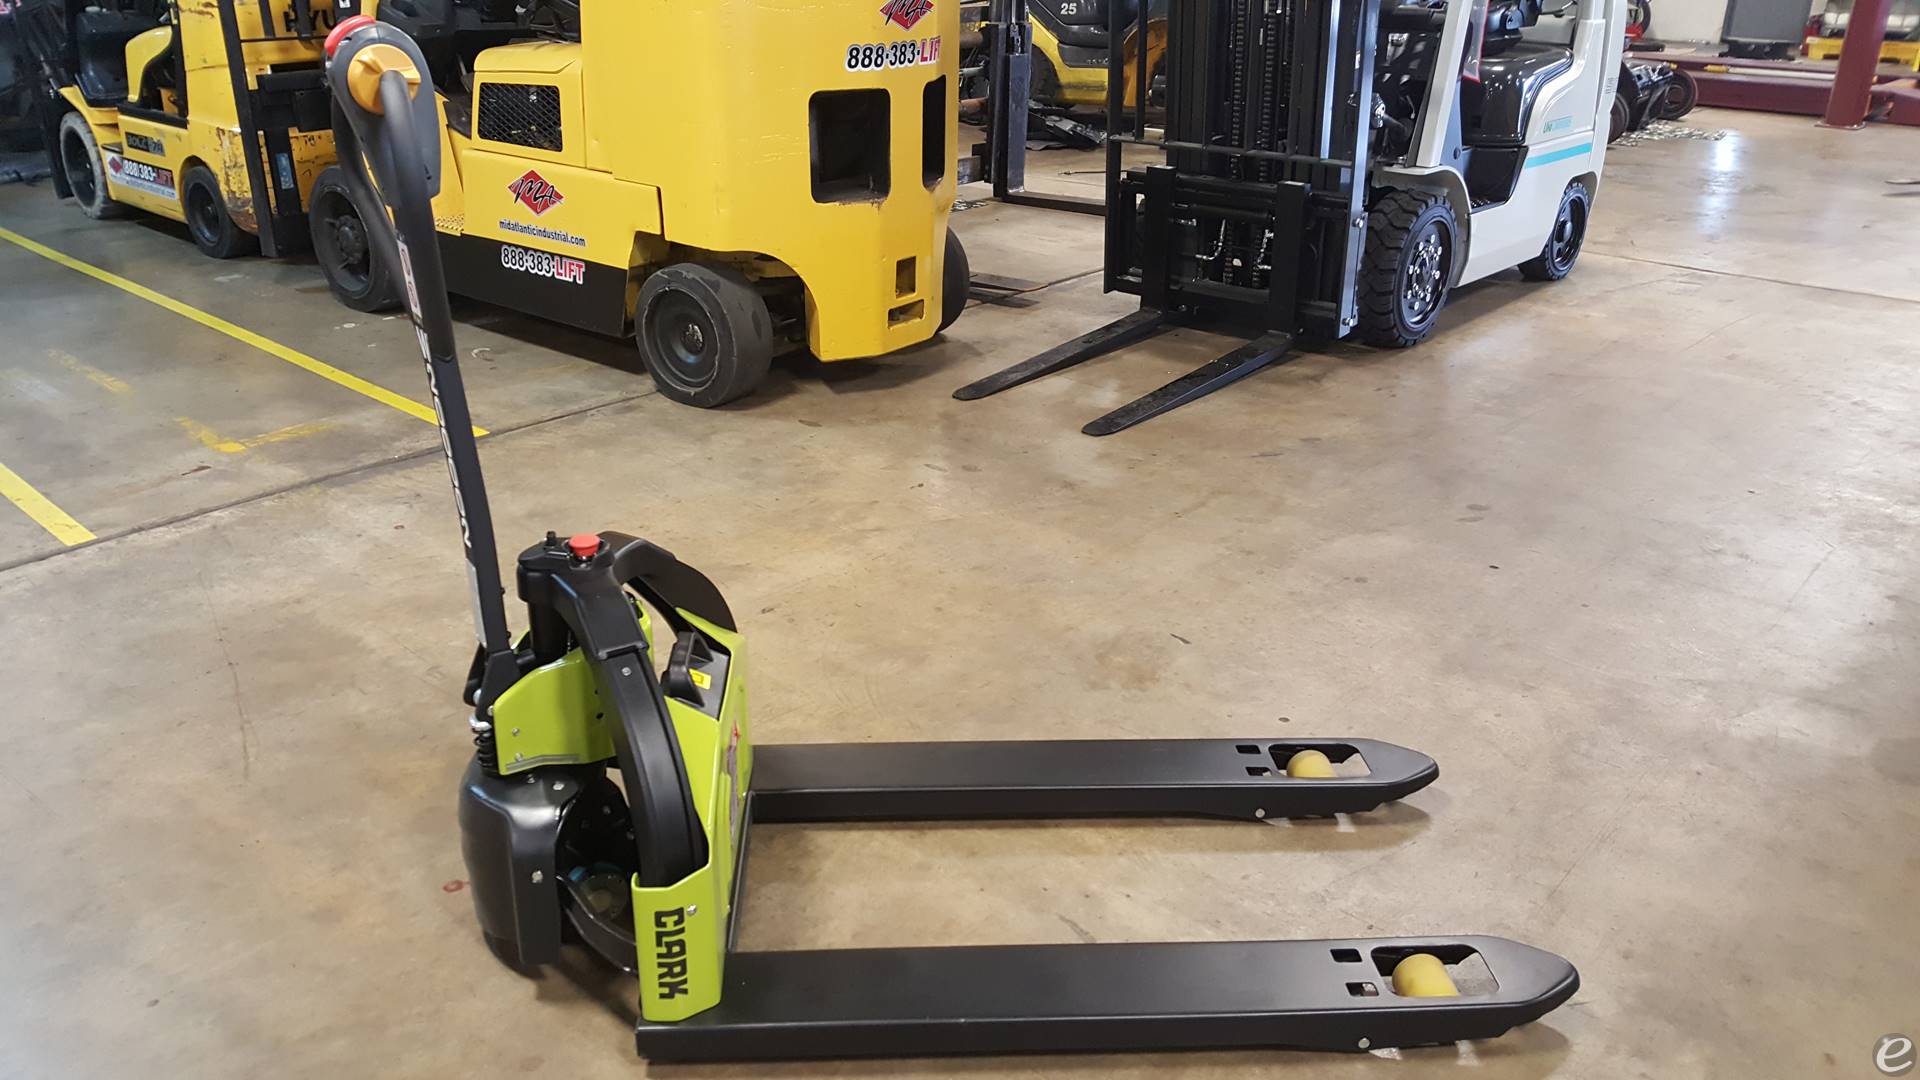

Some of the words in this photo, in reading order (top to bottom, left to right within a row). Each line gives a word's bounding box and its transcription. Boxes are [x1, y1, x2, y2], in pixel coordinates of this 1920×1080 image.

[1060, 2, 1077, 15] 25
[499, 219, 586, 247] midatlanticindustrial.com
[654, 907, 688, 999] CLARK
